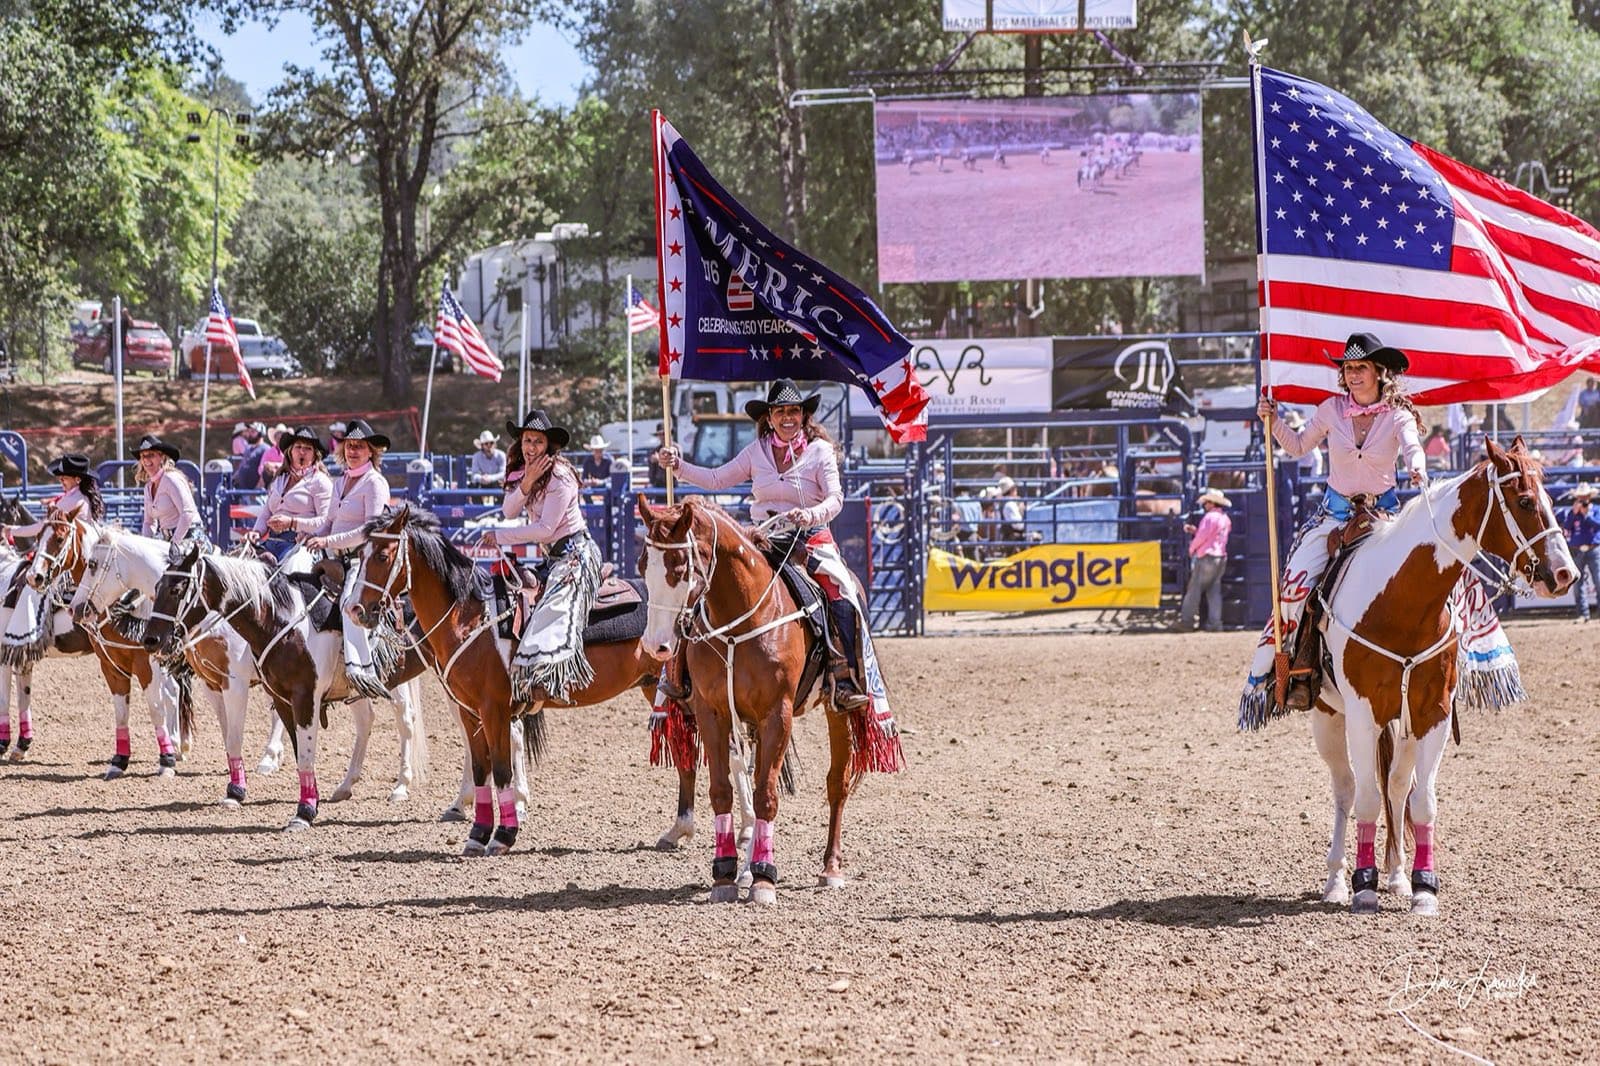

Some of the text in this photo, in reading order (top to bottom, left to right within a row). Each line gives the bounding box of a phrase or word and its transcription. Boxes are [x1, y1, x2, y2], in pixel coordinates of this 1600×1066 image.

[945, 15, 1132, 28] HAZARUS MATERIALS DMOLITION
[681, 197, 861, 349] MERICA
[947, 551, 1130, 604] Wrangler
